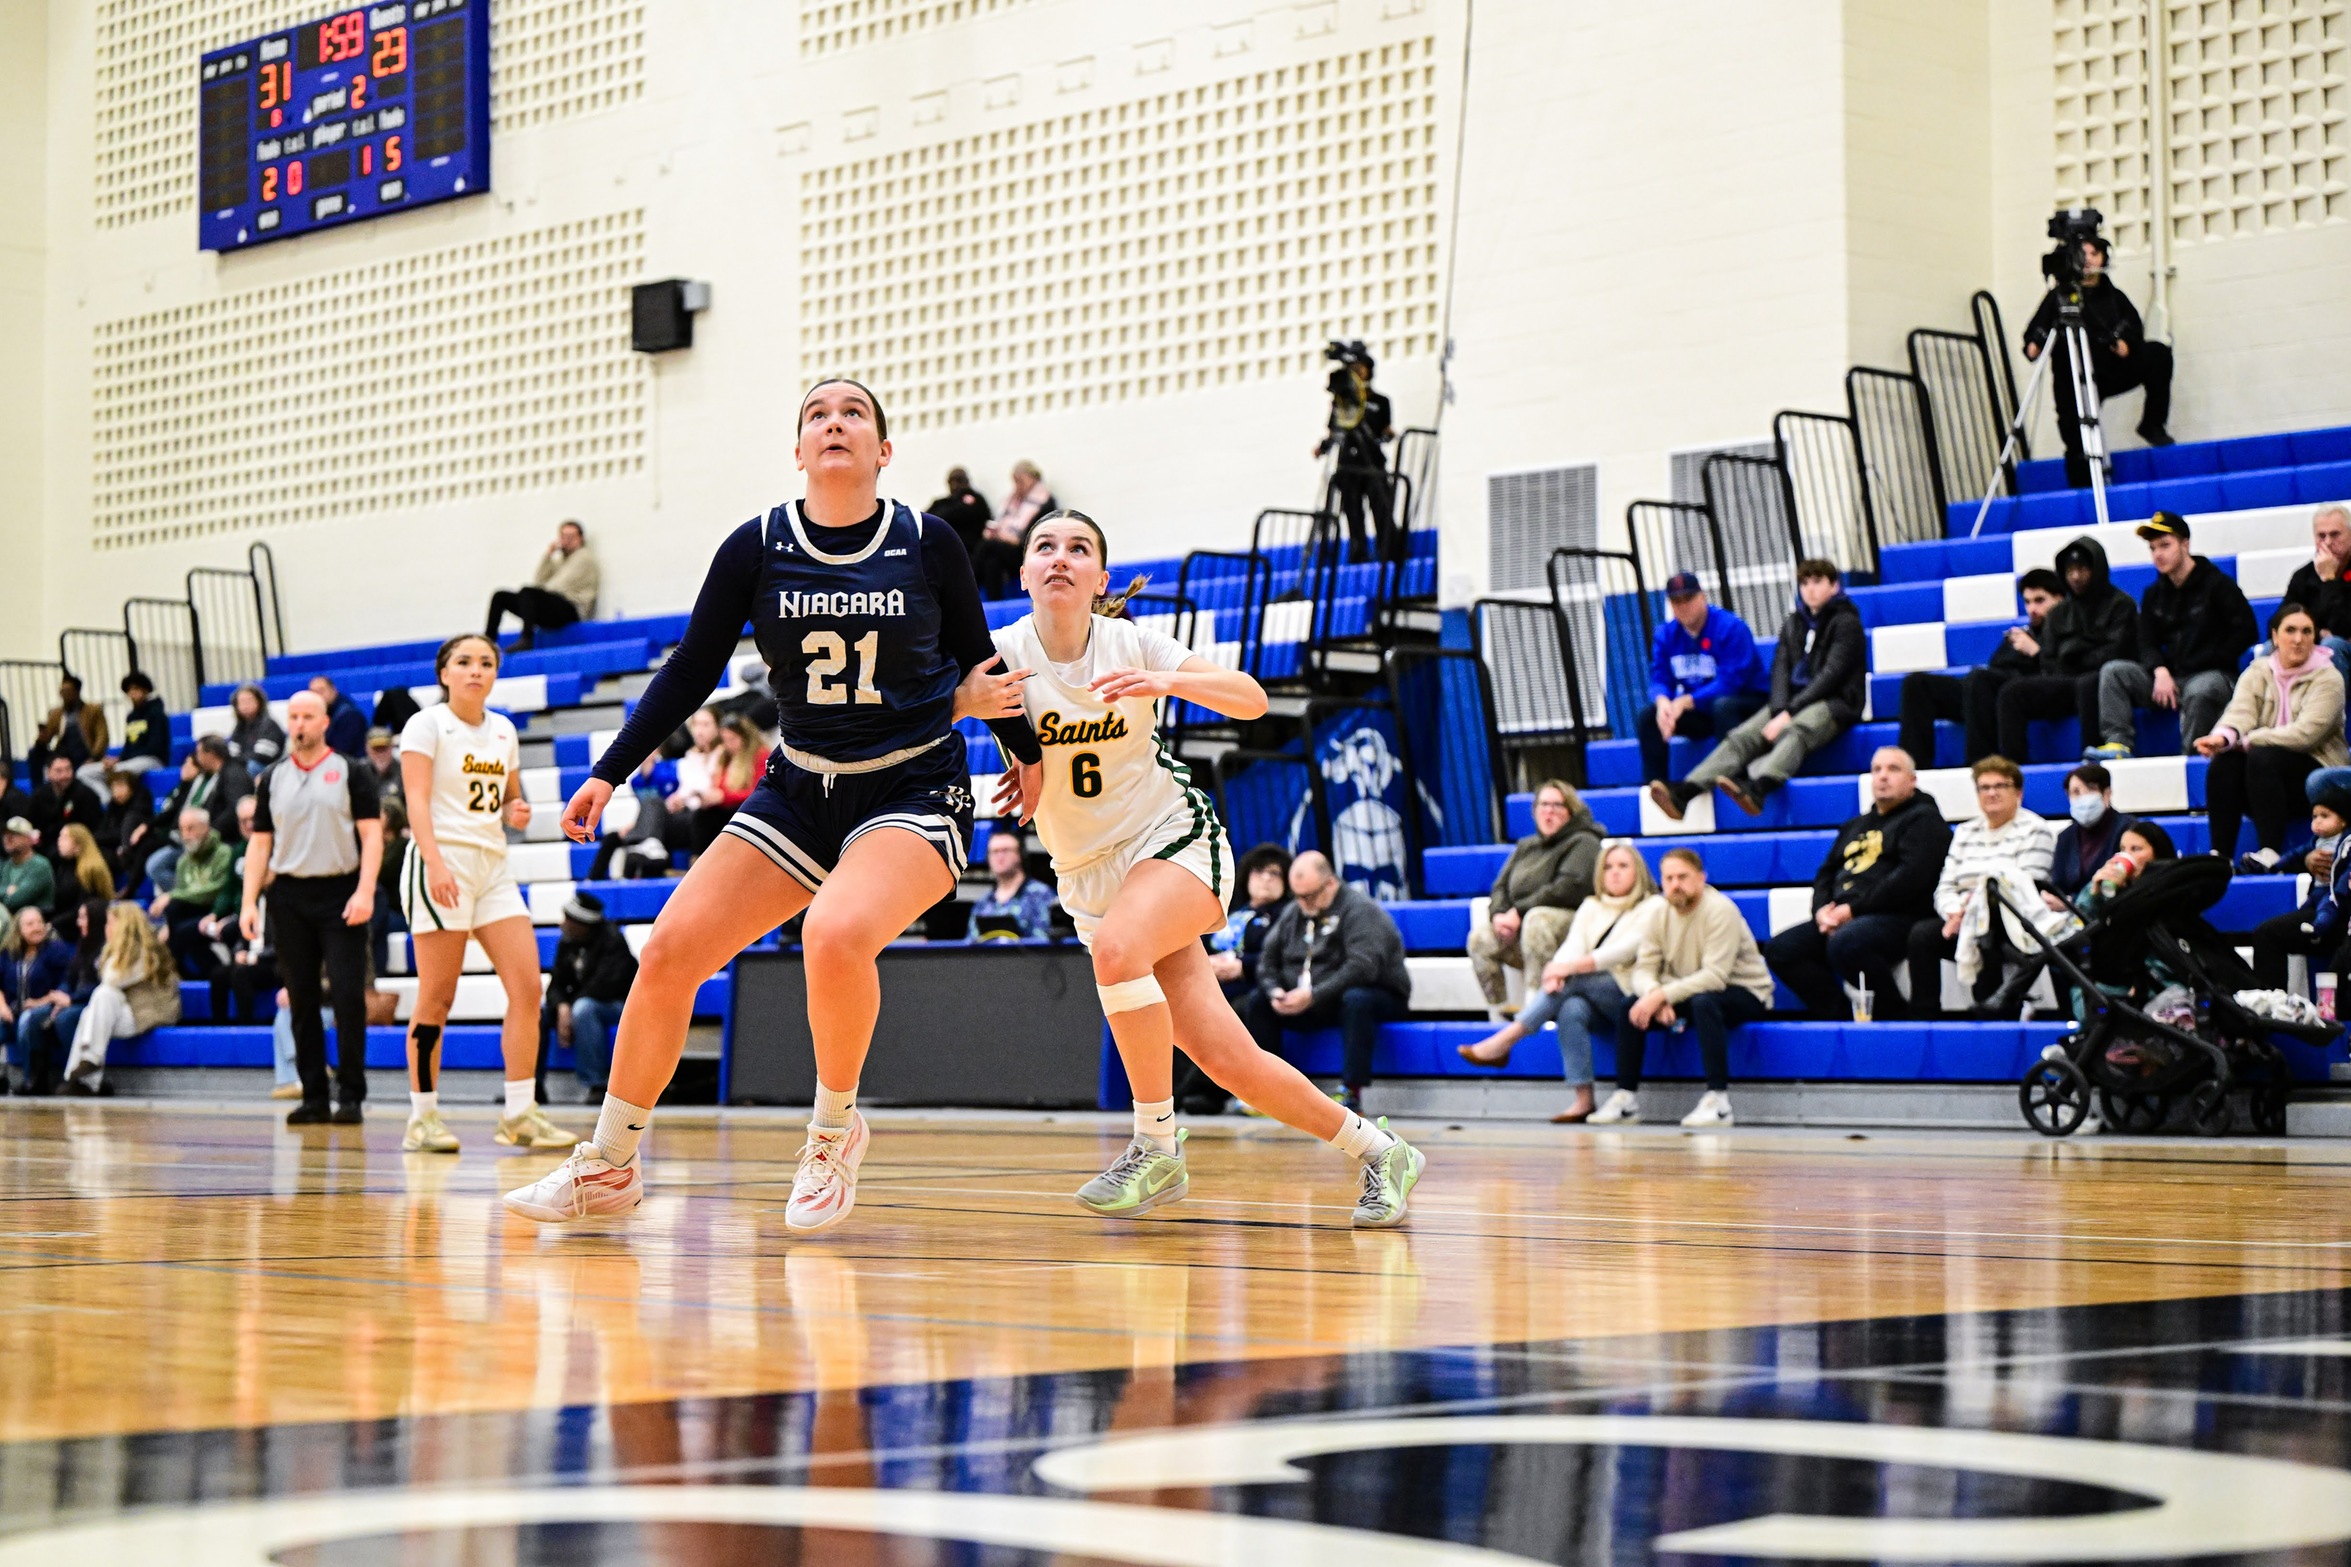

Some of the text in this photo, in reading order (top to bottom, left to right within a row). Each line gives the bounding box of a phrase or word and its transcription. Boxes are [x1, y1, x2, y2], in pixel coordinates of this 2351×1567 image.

[319, 11, 364, 63] 1:59
[372, 26, 407, 78] 23
[260, 61, 292, 109] 31
[351, 74, 367, 110] 2
[362, 145, 372, 175] 1
[385, 135, 402, 171] 5
[262, 166, 279, 202] 2
[883, 548, 907, 557] OCAA
[778, 588, 906, 618] NIAGARA
[801, 630, 882, 705] 21
[1036, 710, 1129, 746] Saints
[1070, 751, 1103, 798] 6
[468, 779, 501, 813] 23
